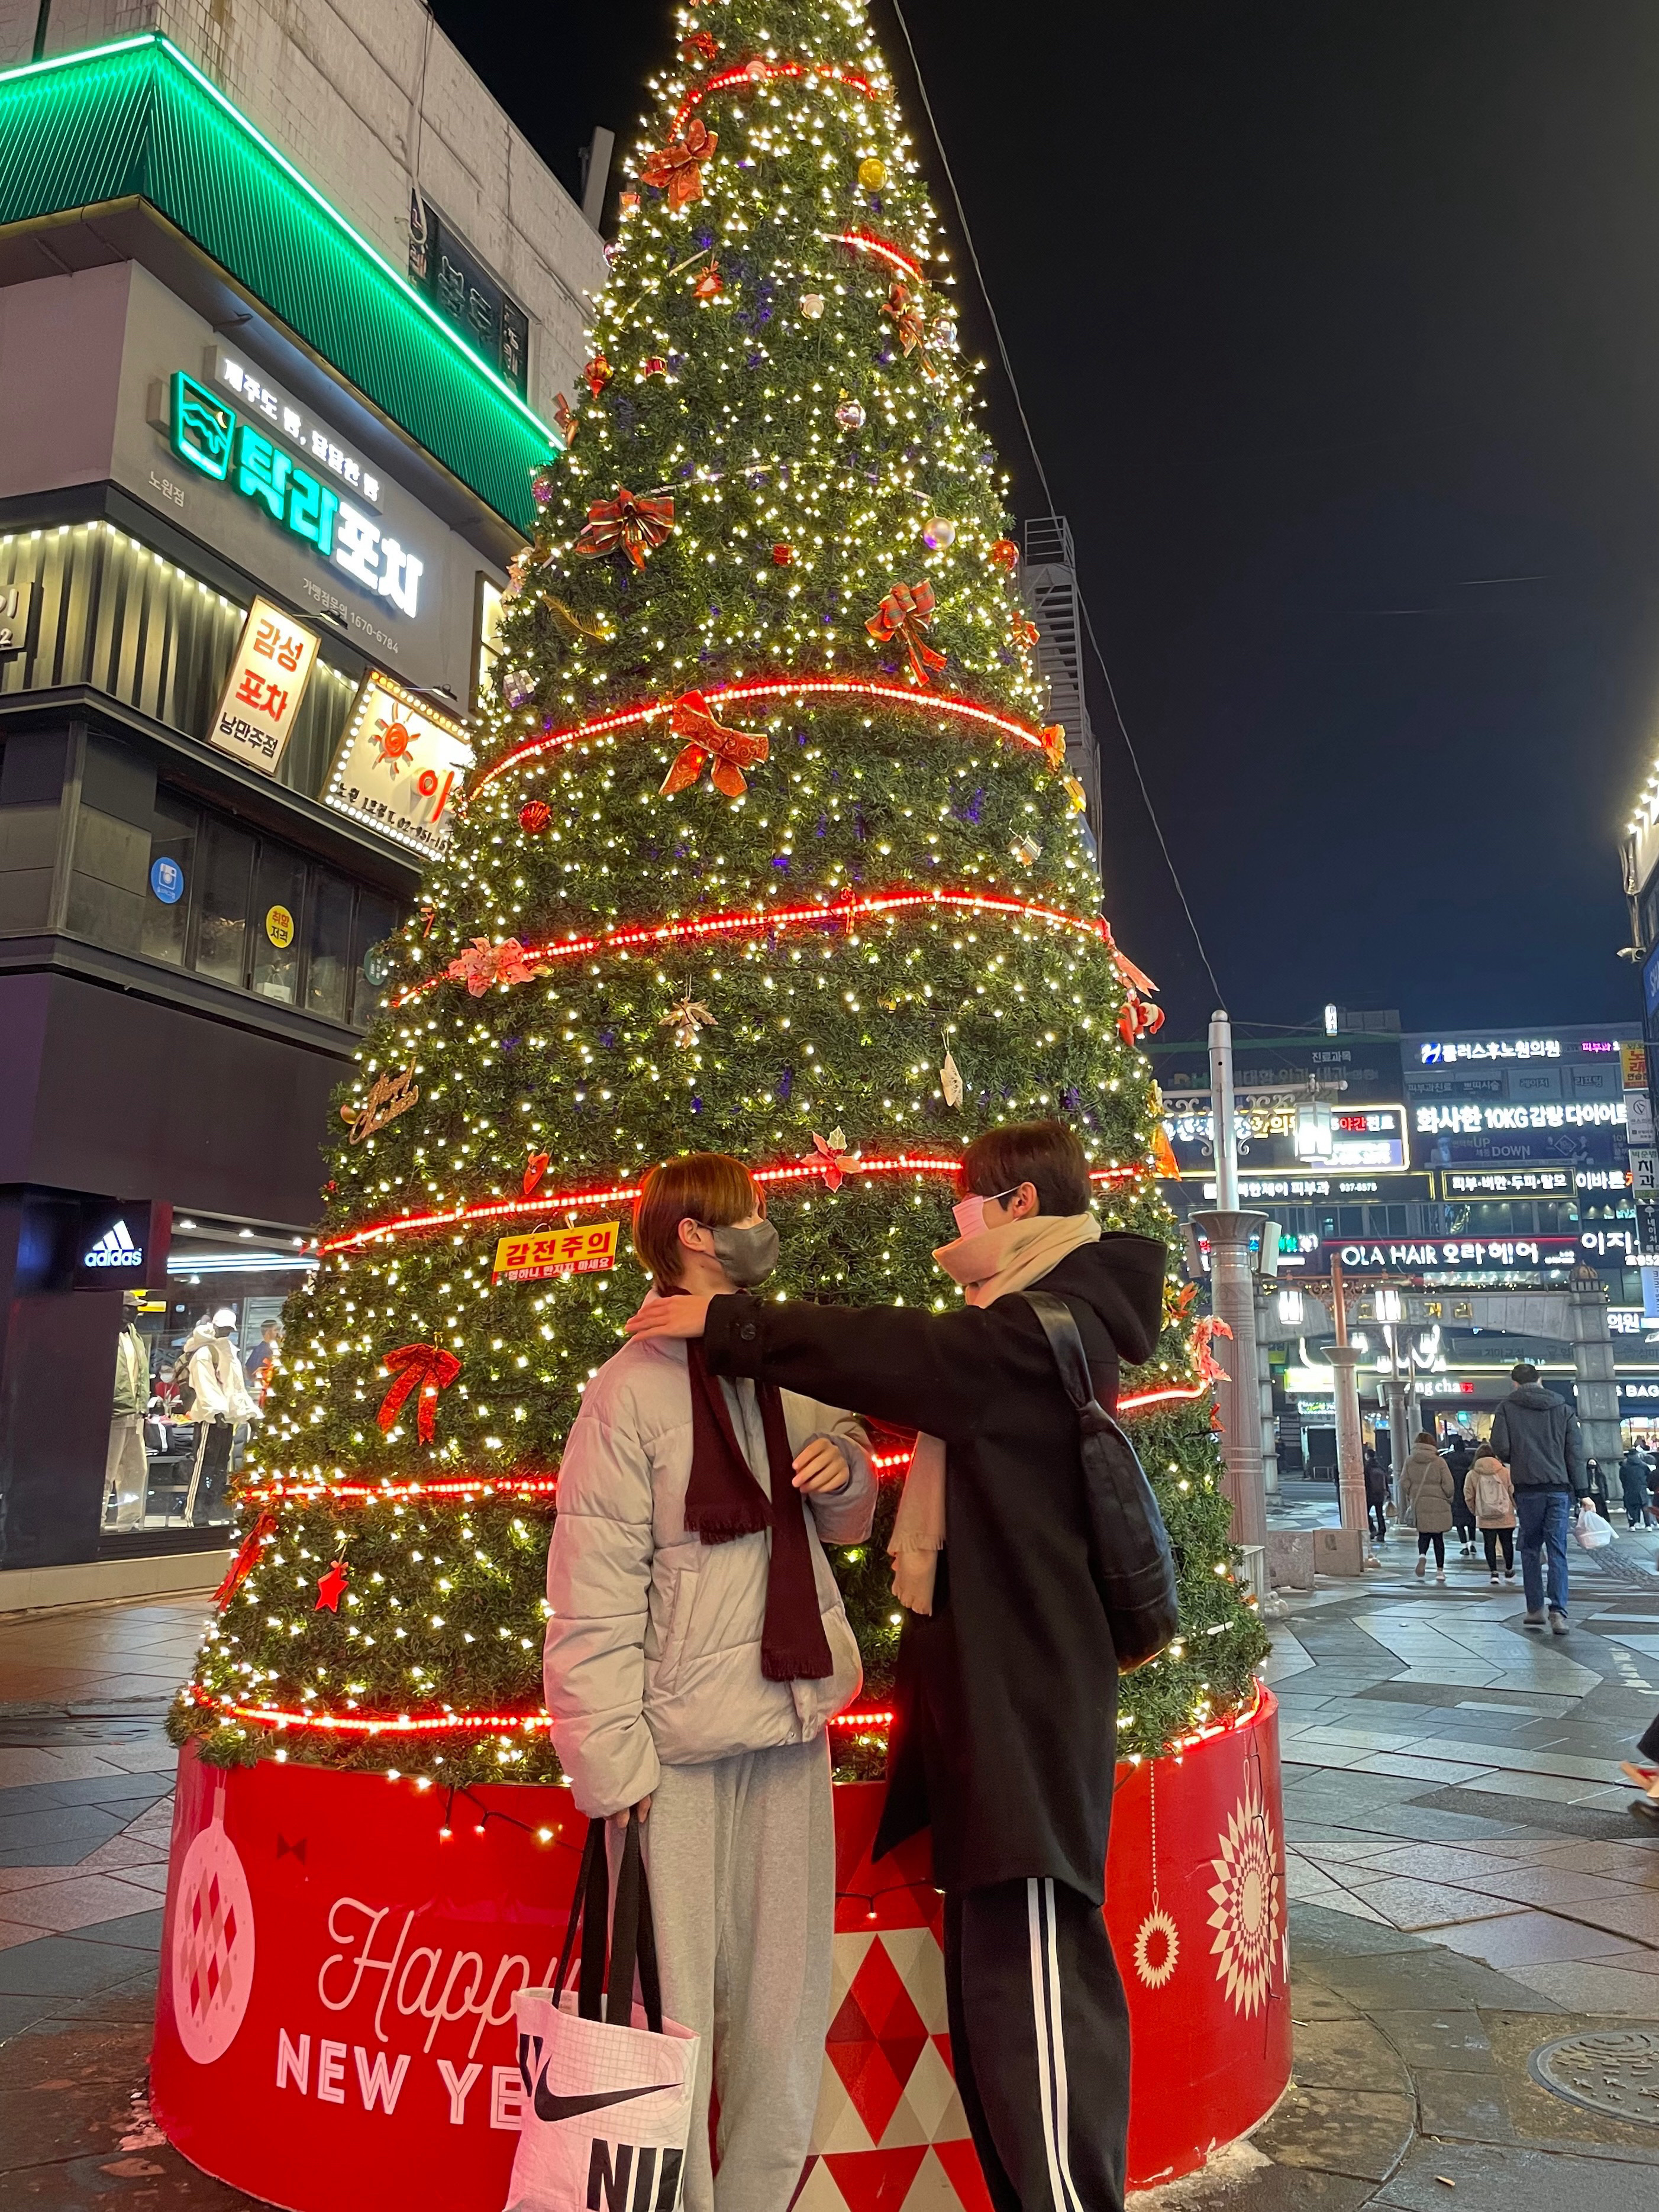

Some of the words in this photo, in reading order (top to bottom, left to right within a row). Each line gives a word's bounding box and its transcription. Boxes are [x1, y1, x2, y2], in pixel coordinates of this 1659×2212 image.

[224, 358, 277, 420] 제주도
[149, 470, 185, 507] 노원점
[253, 618, 304, 673] 감성
[350, 611, 399, 654] 1670-6784
[235, 669, 289, 723] 포차
[219, 712, 279, 759] 낭만주점
[270, 926, 288, 943] 저격
[1416, 1104, 1483, 1134] 화사한
[1484, 1106, 1529, 1129] 10KG
[1529, 1104, 1564, 1129] 감량
[1565, 1102, 1628, 1127] 다이어트
[1638, 1160, 1655, 1189] 치과
[84, 1247, 143, 1267] adidas
[498, 1267, 540, 1281] 험하니
[577, 1257, 609, 1271] 마세요
[1341, 1245, 1386, 1266] OLA
[1390, 1244, 1438, 1265] HAIR
[1435, 1378, 1461, 1393] cha
[276, 2027, 411, 2116] NEW
